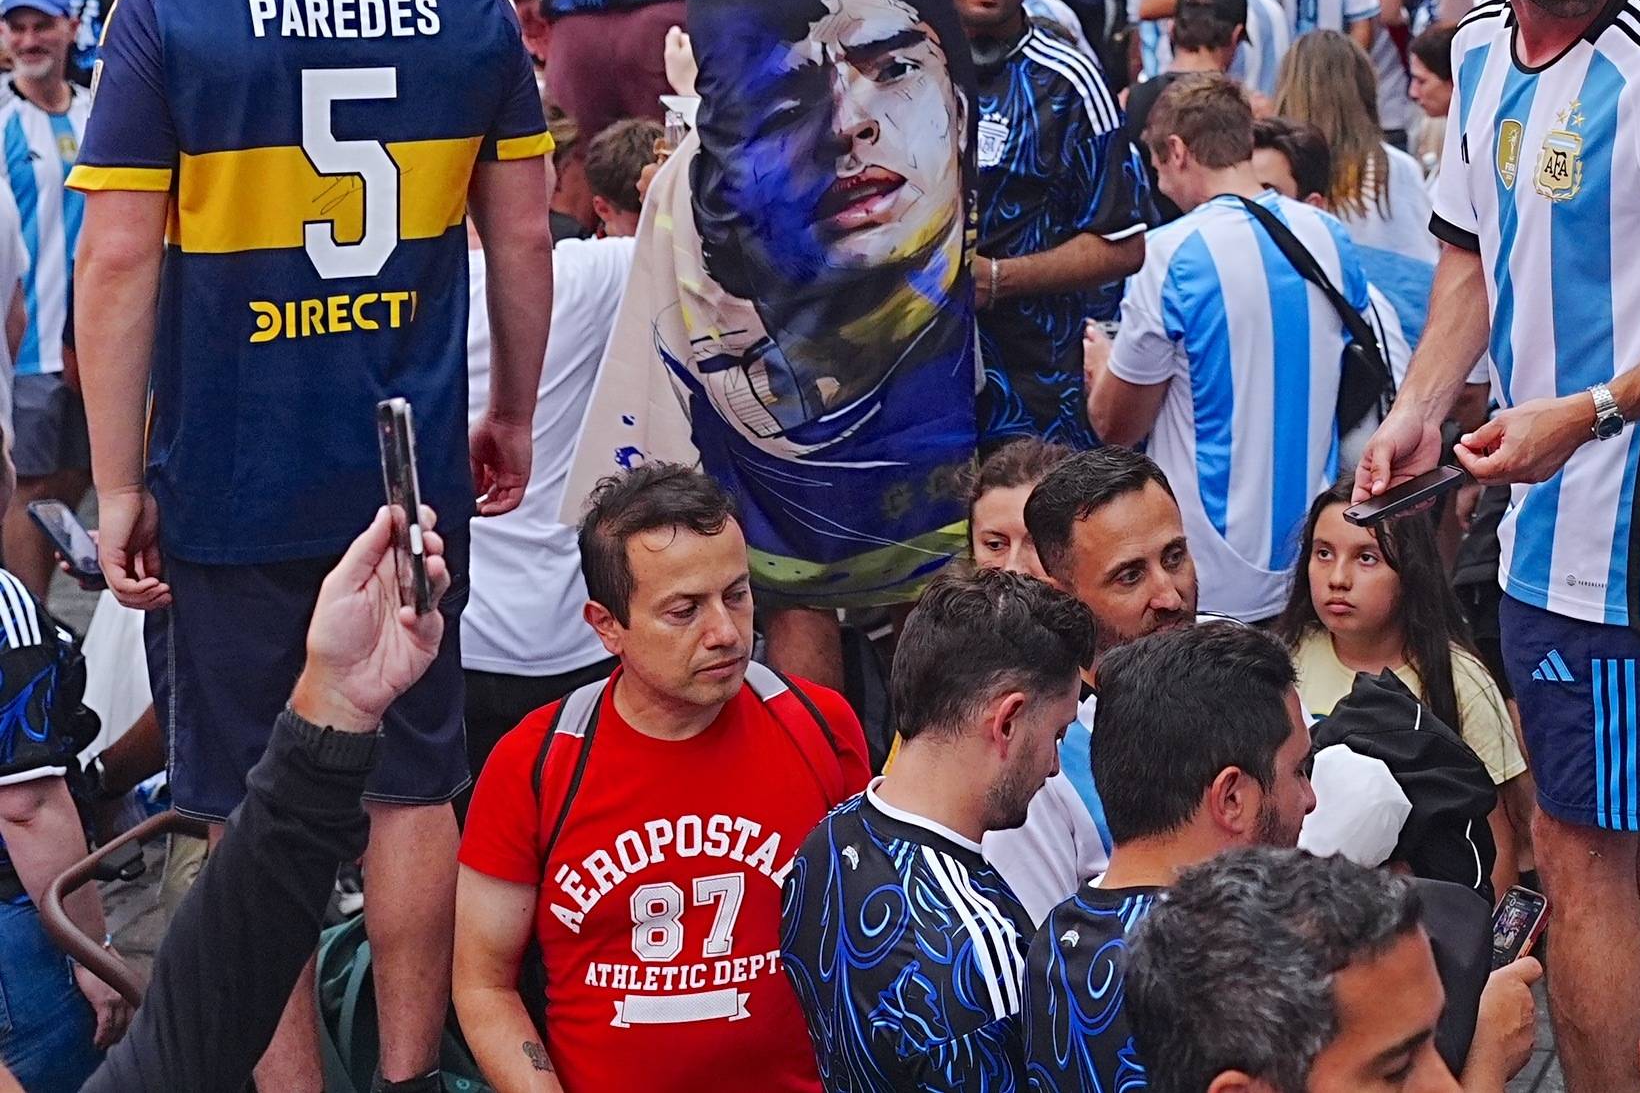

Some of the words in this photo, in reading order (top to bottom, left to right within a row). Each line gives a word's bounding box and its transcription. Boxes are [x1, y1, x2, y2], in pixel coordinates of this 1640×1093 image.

[301, 66, 399, 280] 5
[1543, 148, 1569, 182] AFA
[248, 291, 419, 343] DIRECT
[629, 871, 746, 962] 87
[584, 961, 707, 991] ATHLETIC
